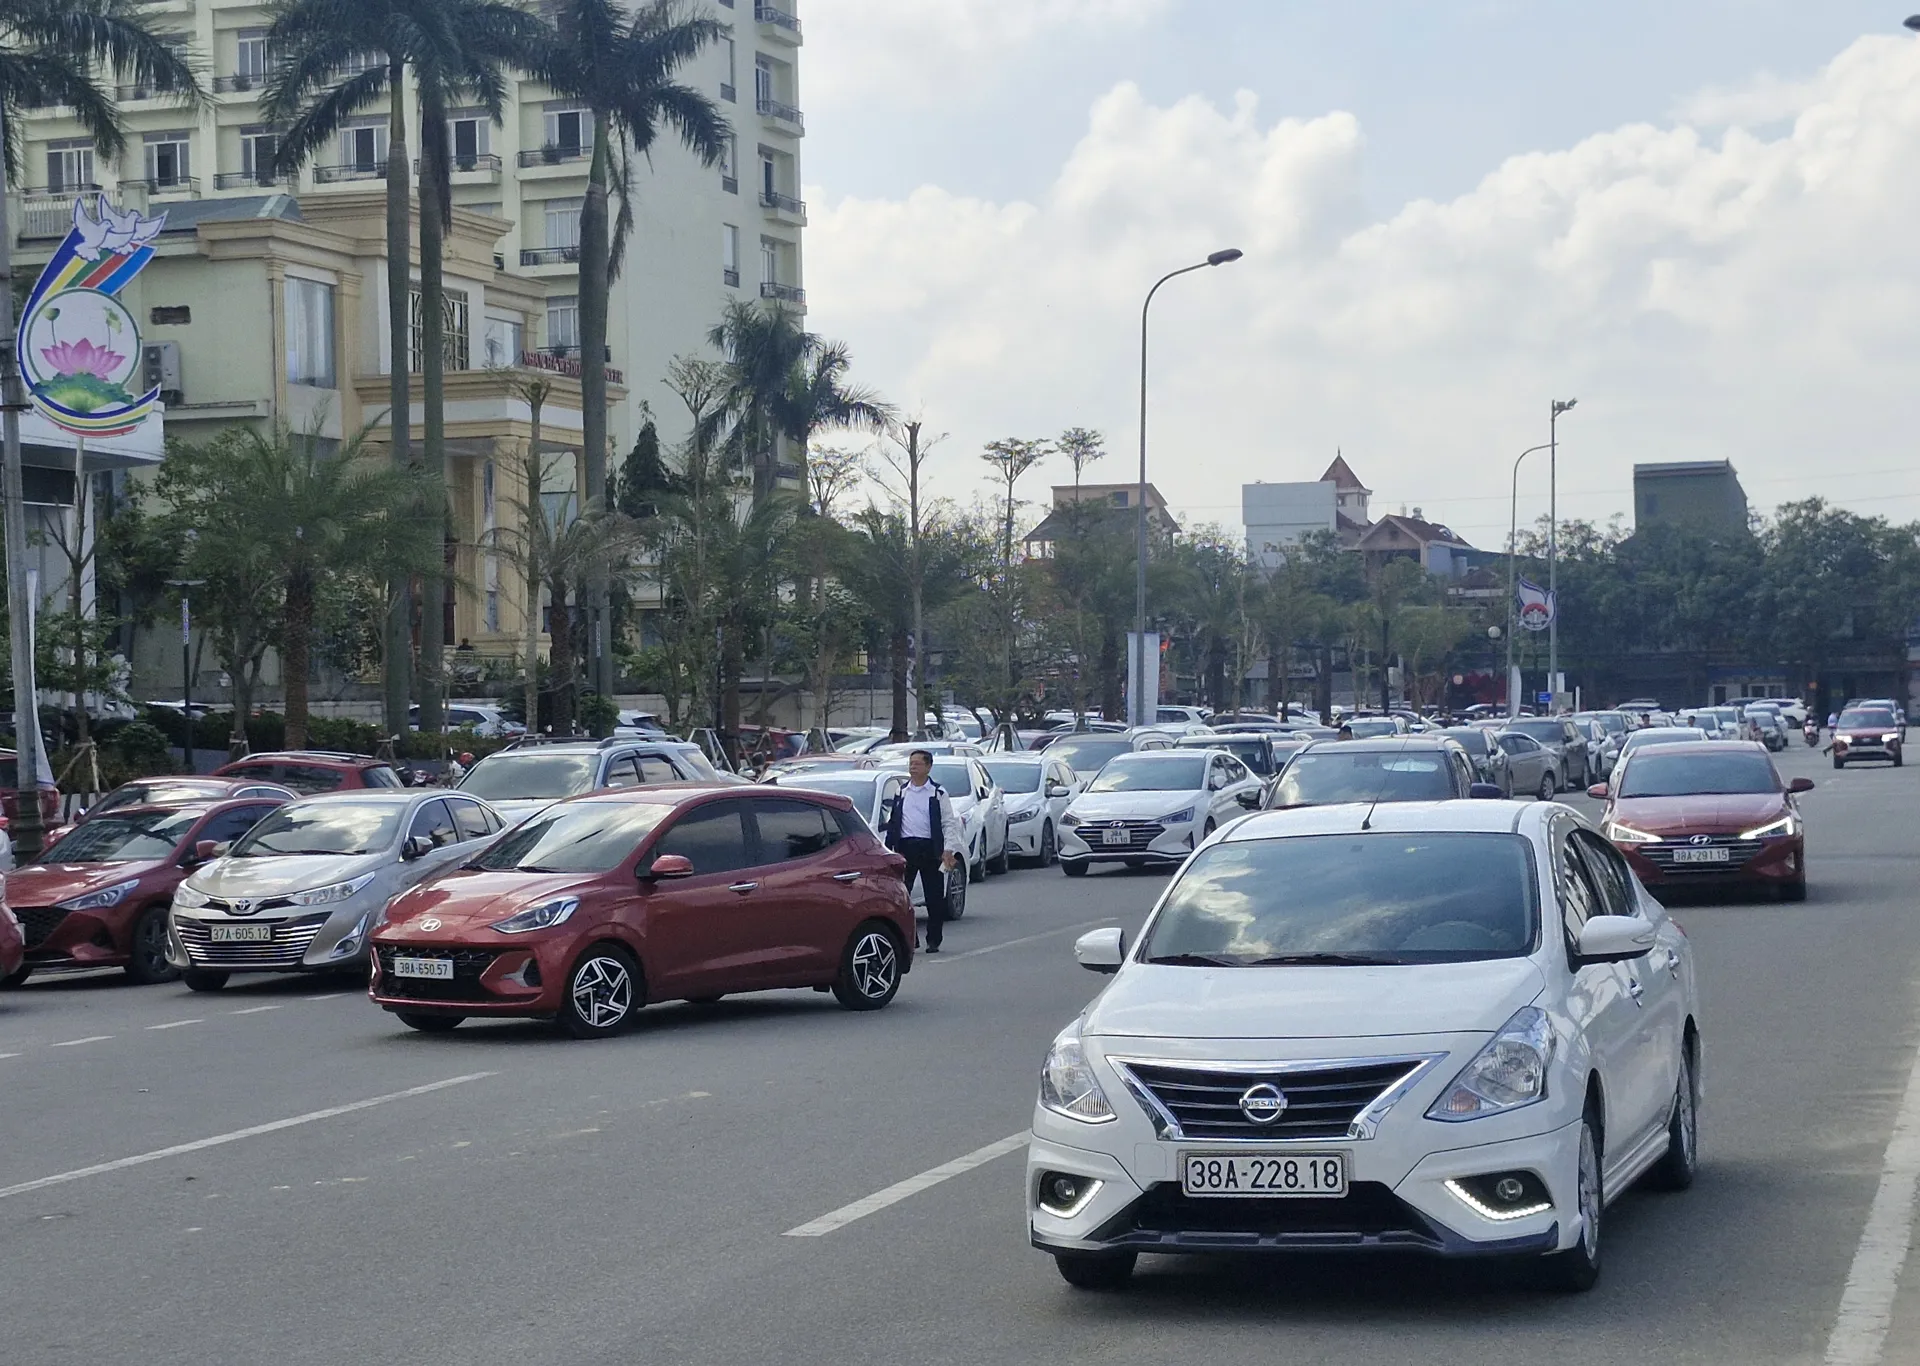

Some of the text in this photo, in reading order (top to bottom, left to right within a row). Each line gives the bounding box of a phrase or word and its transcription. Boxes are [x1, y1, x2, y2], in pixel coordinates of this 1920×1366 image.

[213, 927, 269, 940] 37A-605.12
[399, 962, 448, 976] 38A-650.57
[1191, 1159, 1339, 1189] 38A-228.18
